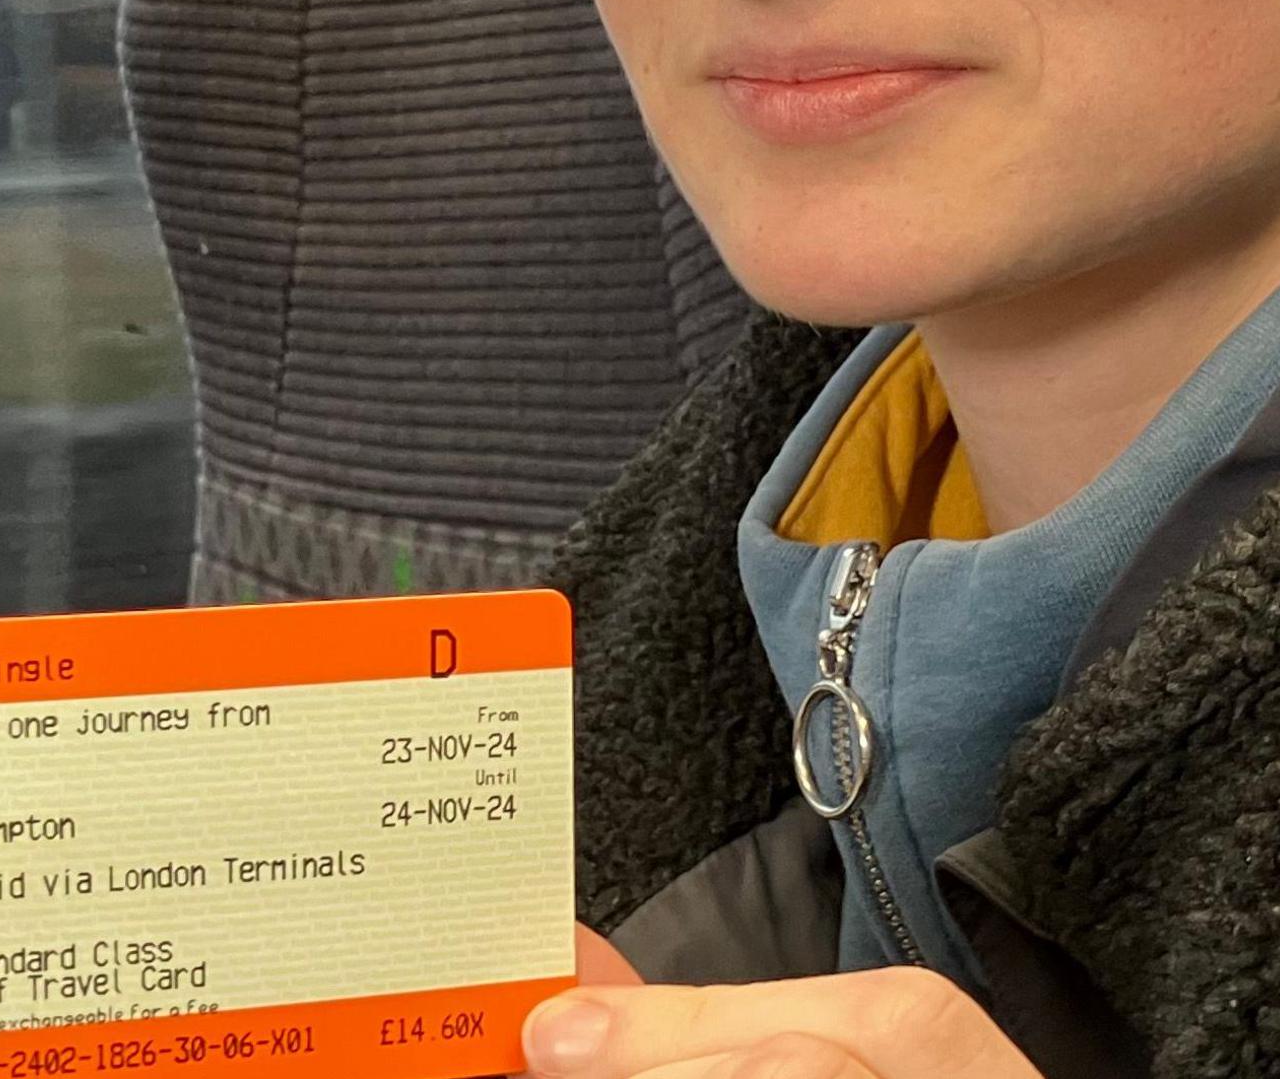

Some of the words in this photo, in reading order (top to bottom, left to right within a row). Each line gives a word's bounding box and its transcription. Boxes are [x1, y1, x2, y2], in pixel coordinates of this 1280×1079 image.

[431, 629, 457, 678] D
[7, 715, 58, 739] one
[76, 708, 189, 735] journey
[207, 702, 271, 728] from
[477, 706, 519, 723] From
[382, 732, 517, 764] 23-NOV-24
[475, 768, 517, 785] Until
[381, 794, 517, 828] 24-NOV-24
[43, 869, 92, 897] via
[108, 862, 206, 892] London
[223, 850, 366, 884] Terminals
[93, 940, 173, 967] Class
[28, 967, 123, 1001] Travel
[141, 961, 207, 991] Card
[130, 1003, 161, 1021] for
[169, 1006, 180, 1018] a
[187, 999, 219, 1016] fee
